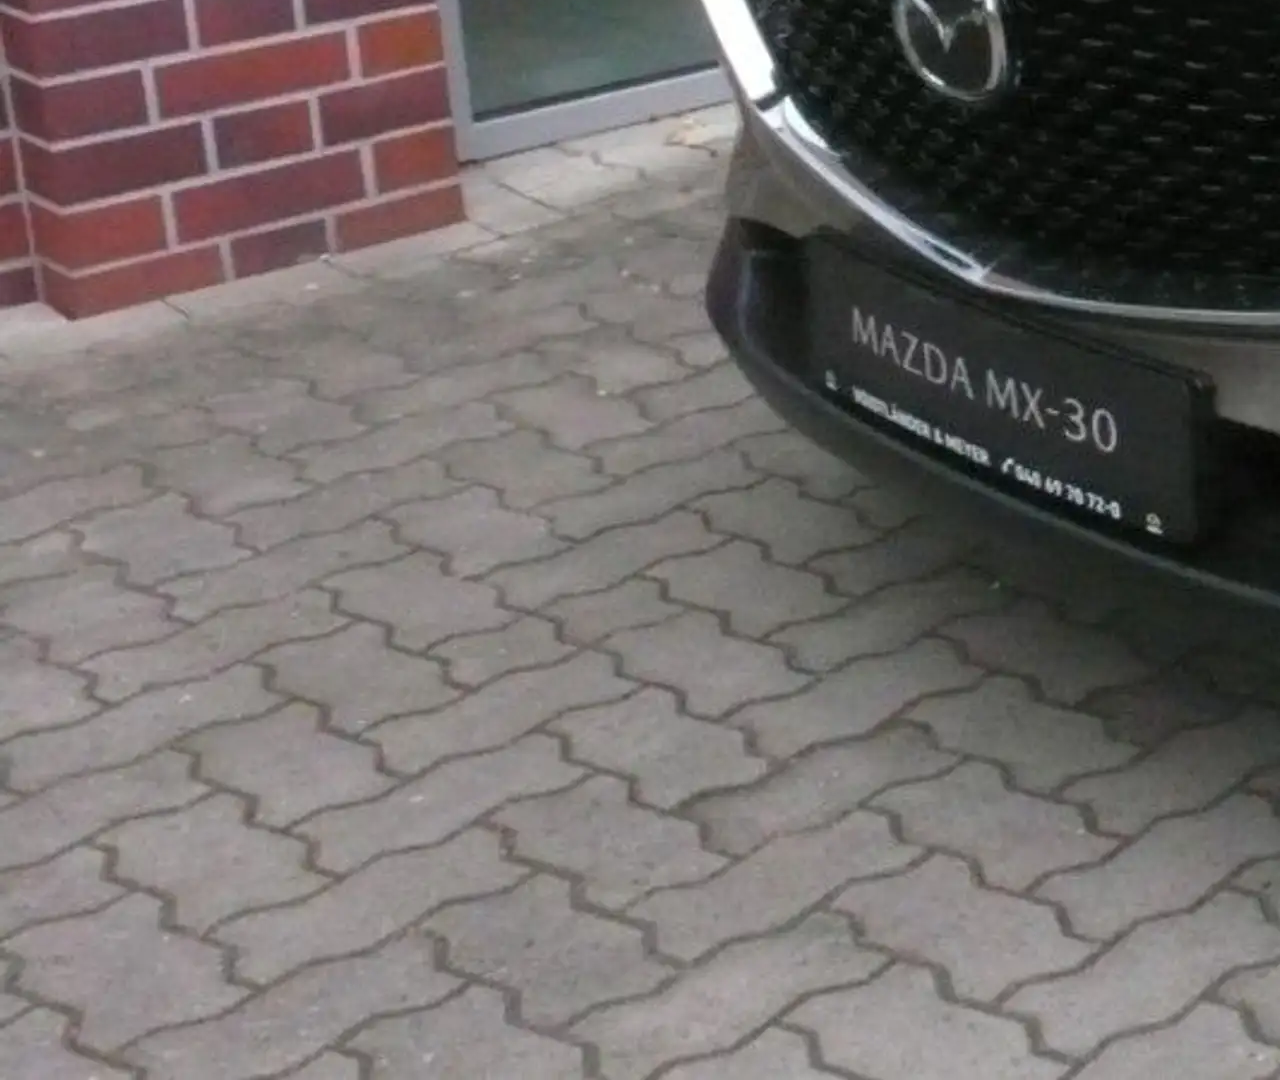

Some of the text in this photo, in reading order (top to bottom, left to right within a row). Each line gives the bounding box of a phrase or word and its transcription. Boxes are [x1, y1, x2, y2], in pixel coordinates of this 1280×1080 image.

[853, 305, 1118, 453] MAZDA MX-30
[945, 433, 992, 466] MEYER
